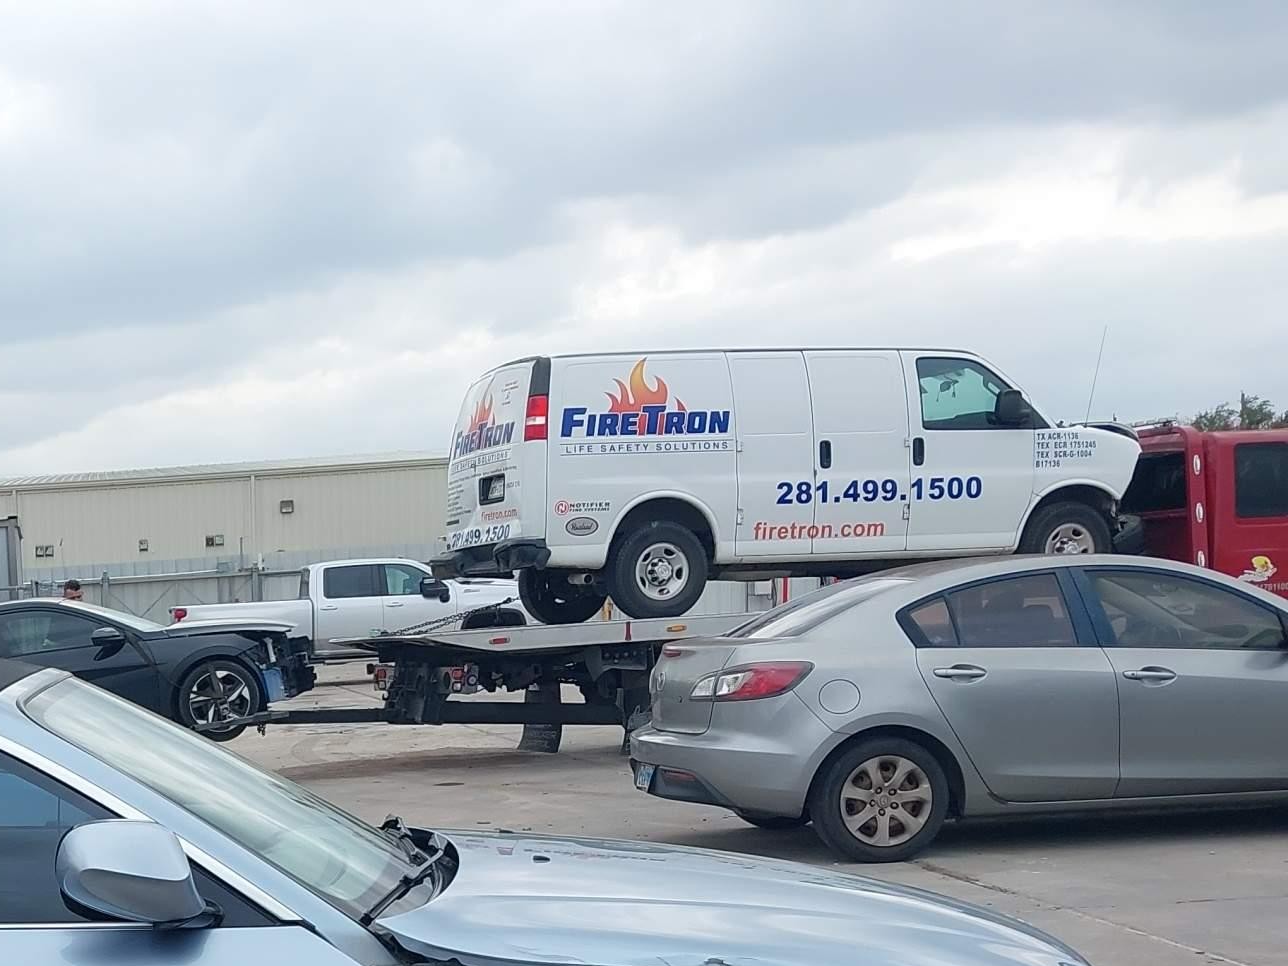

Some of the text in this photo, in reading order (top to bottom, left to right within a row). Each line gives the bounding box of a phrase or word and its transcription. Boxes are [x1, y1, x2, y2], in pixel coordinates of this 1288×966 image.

[566, 441, 729, 454] LIFE SAFETY SOLUTIONS
[776, 477, 982, 504] 281.499.1500
[753, 521, 885, 540] firetron.com
